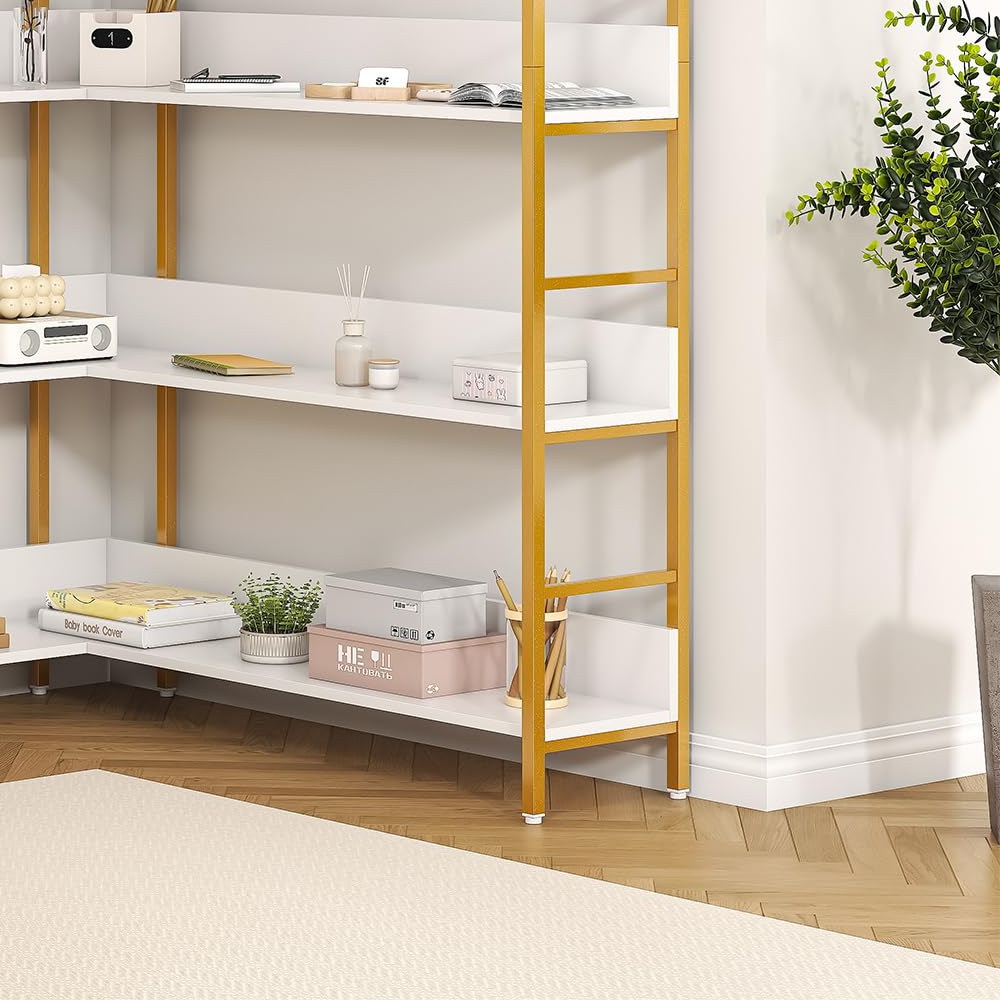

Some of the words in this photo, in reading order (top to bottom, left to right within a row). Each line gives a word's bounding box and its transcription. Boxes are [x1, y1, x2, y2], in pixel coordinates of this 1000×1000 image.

[107, 31, 114, 46] 1
[64, 618, 81, 632] Baby
[83, 622, 100, 634] book
[102, 625, 123, 638] Cover
[338, 644, 365, 666] НЕ
[337, 663, 393, 680] КАНТОВАТЬ
